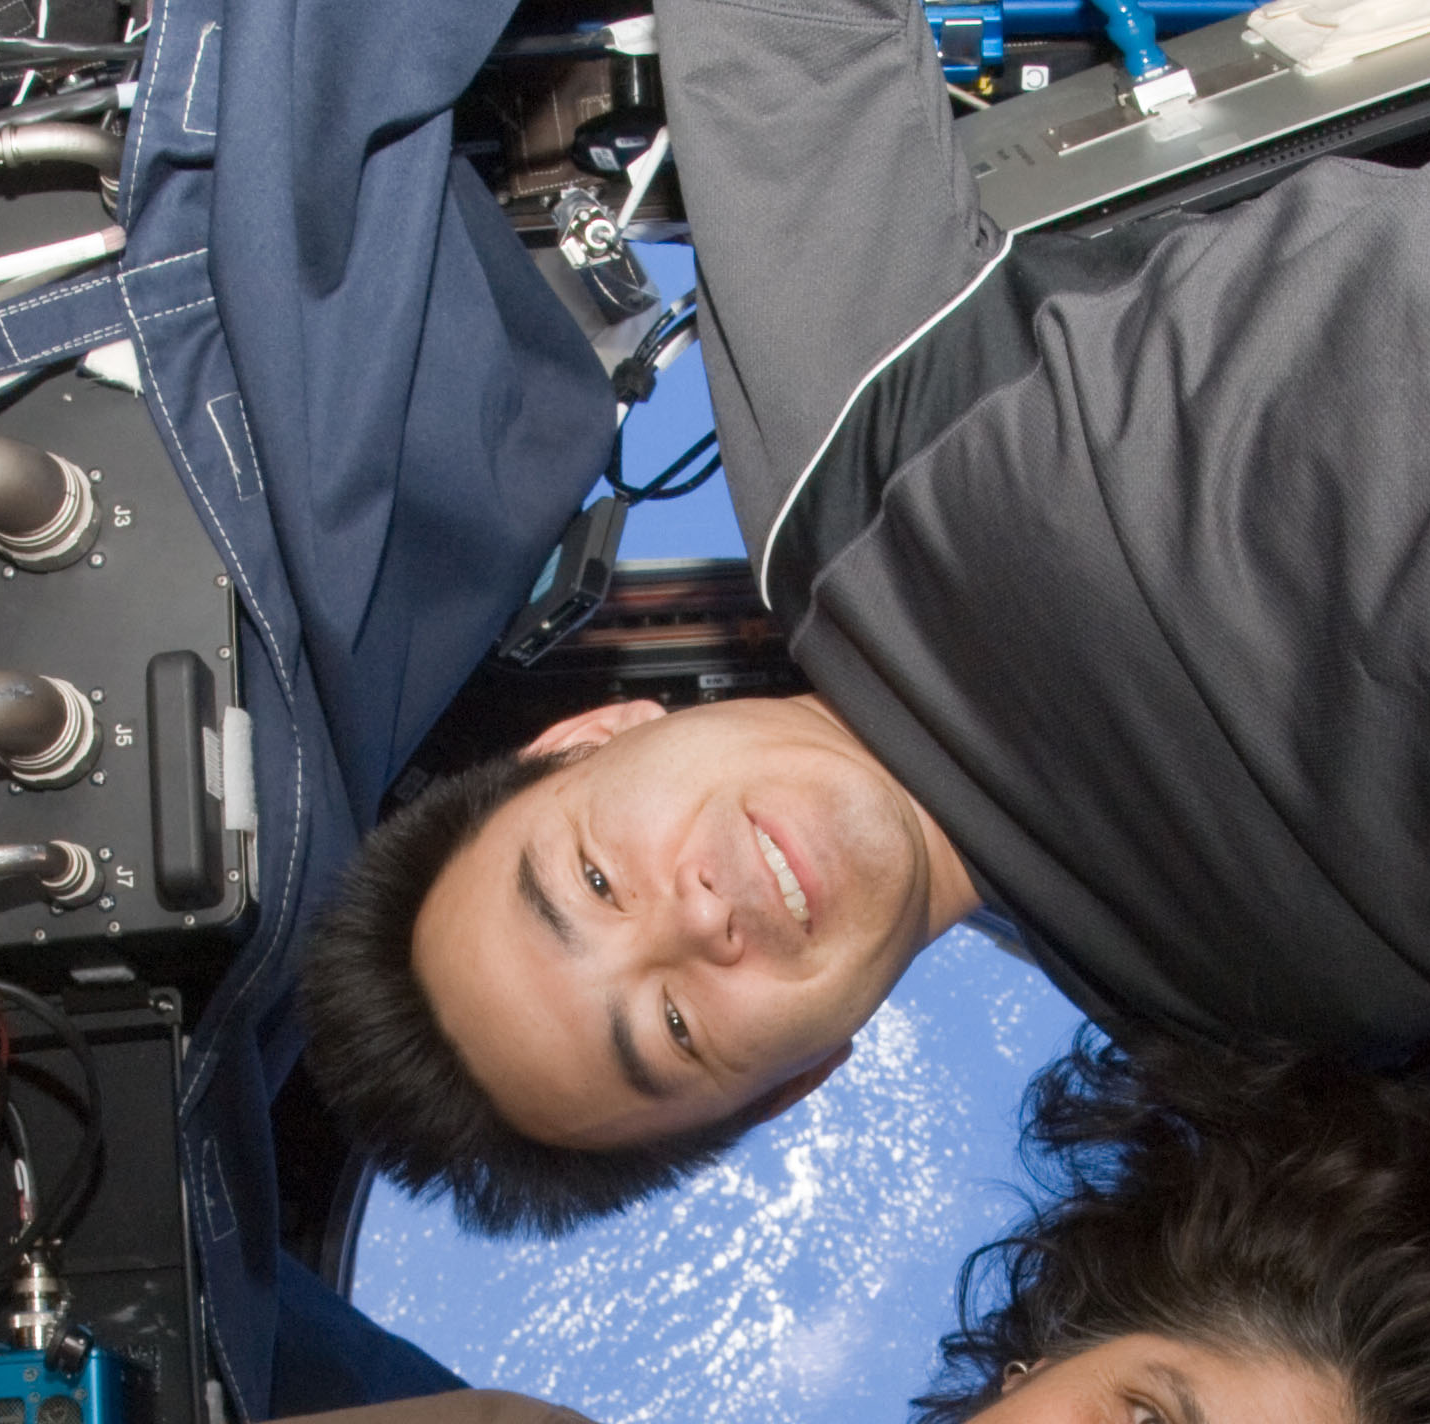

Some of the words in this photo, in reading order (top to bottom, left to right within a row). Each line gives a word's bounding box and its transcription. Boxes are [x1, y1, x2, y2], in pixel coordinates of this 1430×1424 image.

[114, 505, 130, 527] J3
[115, 723, 131, 746] J5
[116, 865, 133, 888] J7
